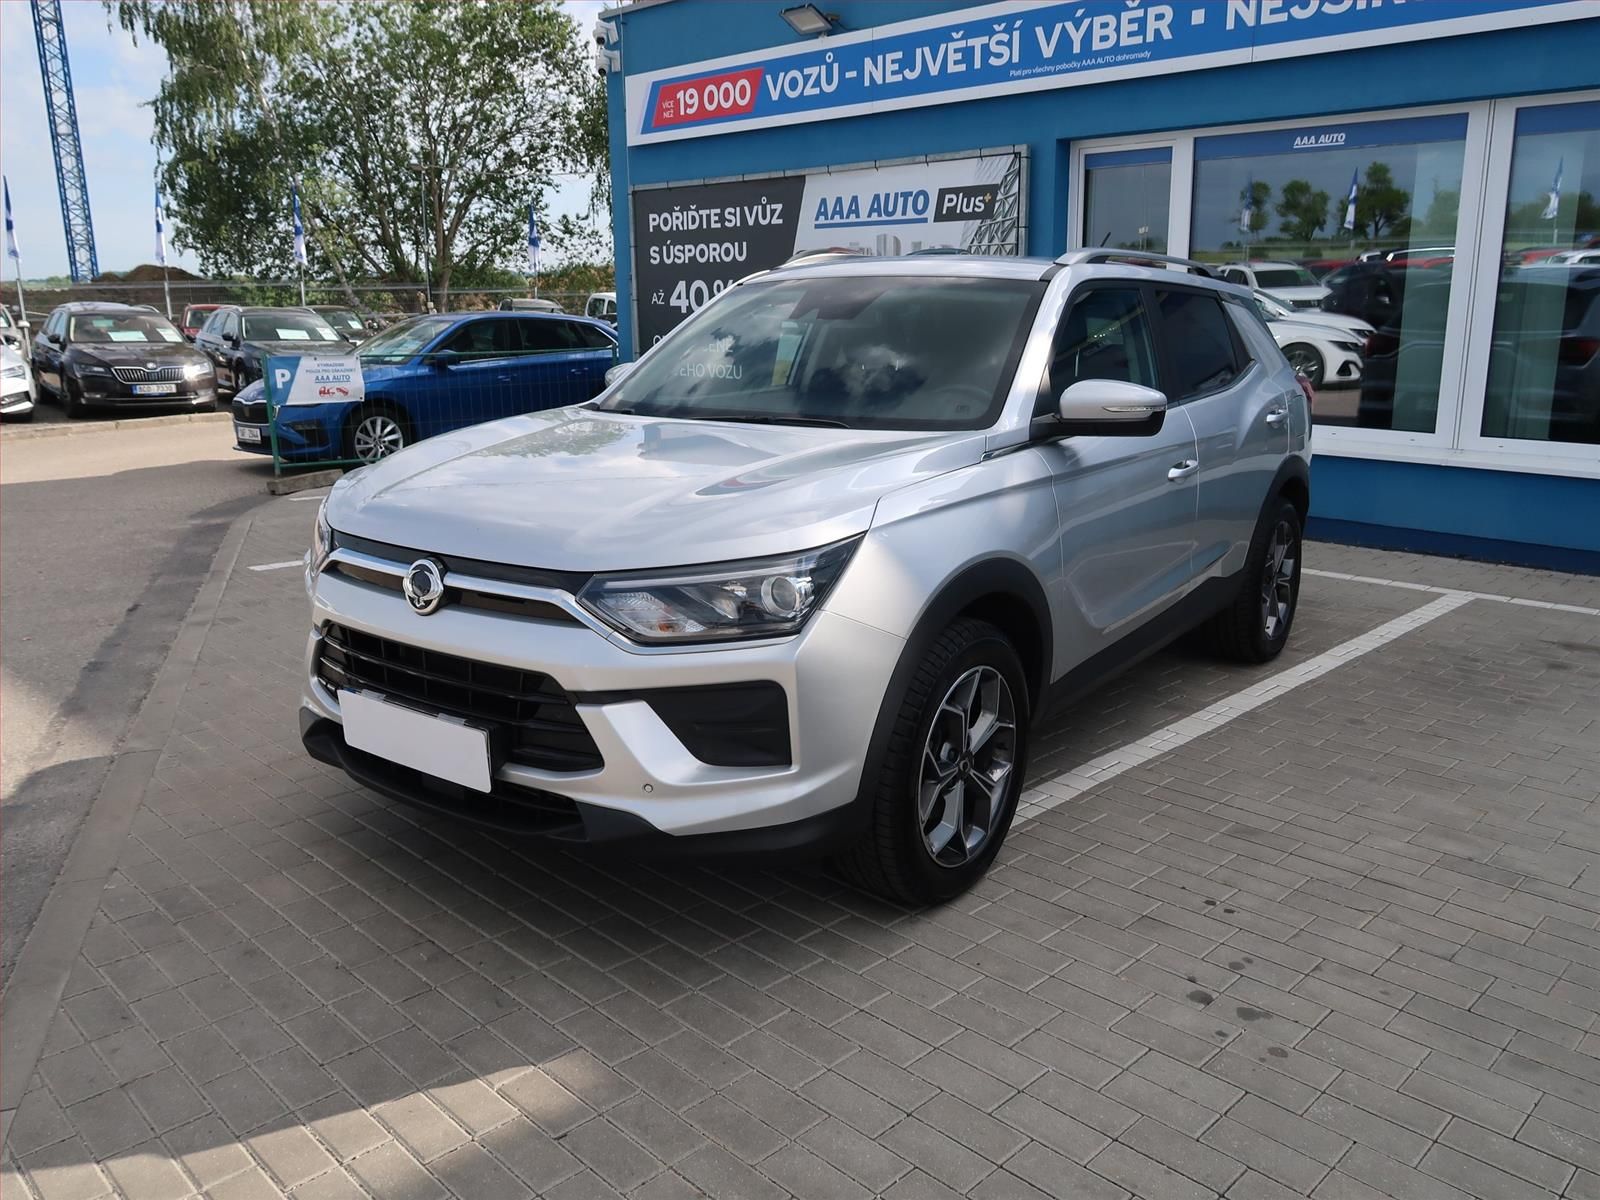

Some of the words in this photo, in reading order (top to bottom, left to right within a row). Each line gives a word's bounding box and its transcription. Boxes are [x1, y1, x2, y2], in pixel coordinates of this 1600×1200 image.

[766, 52, 839, 101] VOZŮ
[864, 20, 1023, 87] NEJVĚTŠÍ
[1035, 0, 1173, 58] VÝBĚR
[1082, 58, 1096, 66] AAA
[1097, 55, 1115, 64] AUTO
[1293, 135, 1315, 148] AAA
[1318, 132, 1346, 145] AUTO
[649, 204, 721, 232] POŘIĎTE
[724, 206, 741, 228] SI
[744, 196, 783, 225] VŮZ
[816, 196, 861, 222] AAA
[867, 189, 930, 218] AUTO
[650, 248, 660, 264] S
[662, 239, 747, 263] ÚSPOROU
[651, 289, 665, 304] AŽ
[275, 369, 291, 389] P
[315, 375, 331, 383] AAA
[332, 374, 351, 382] AUTO
